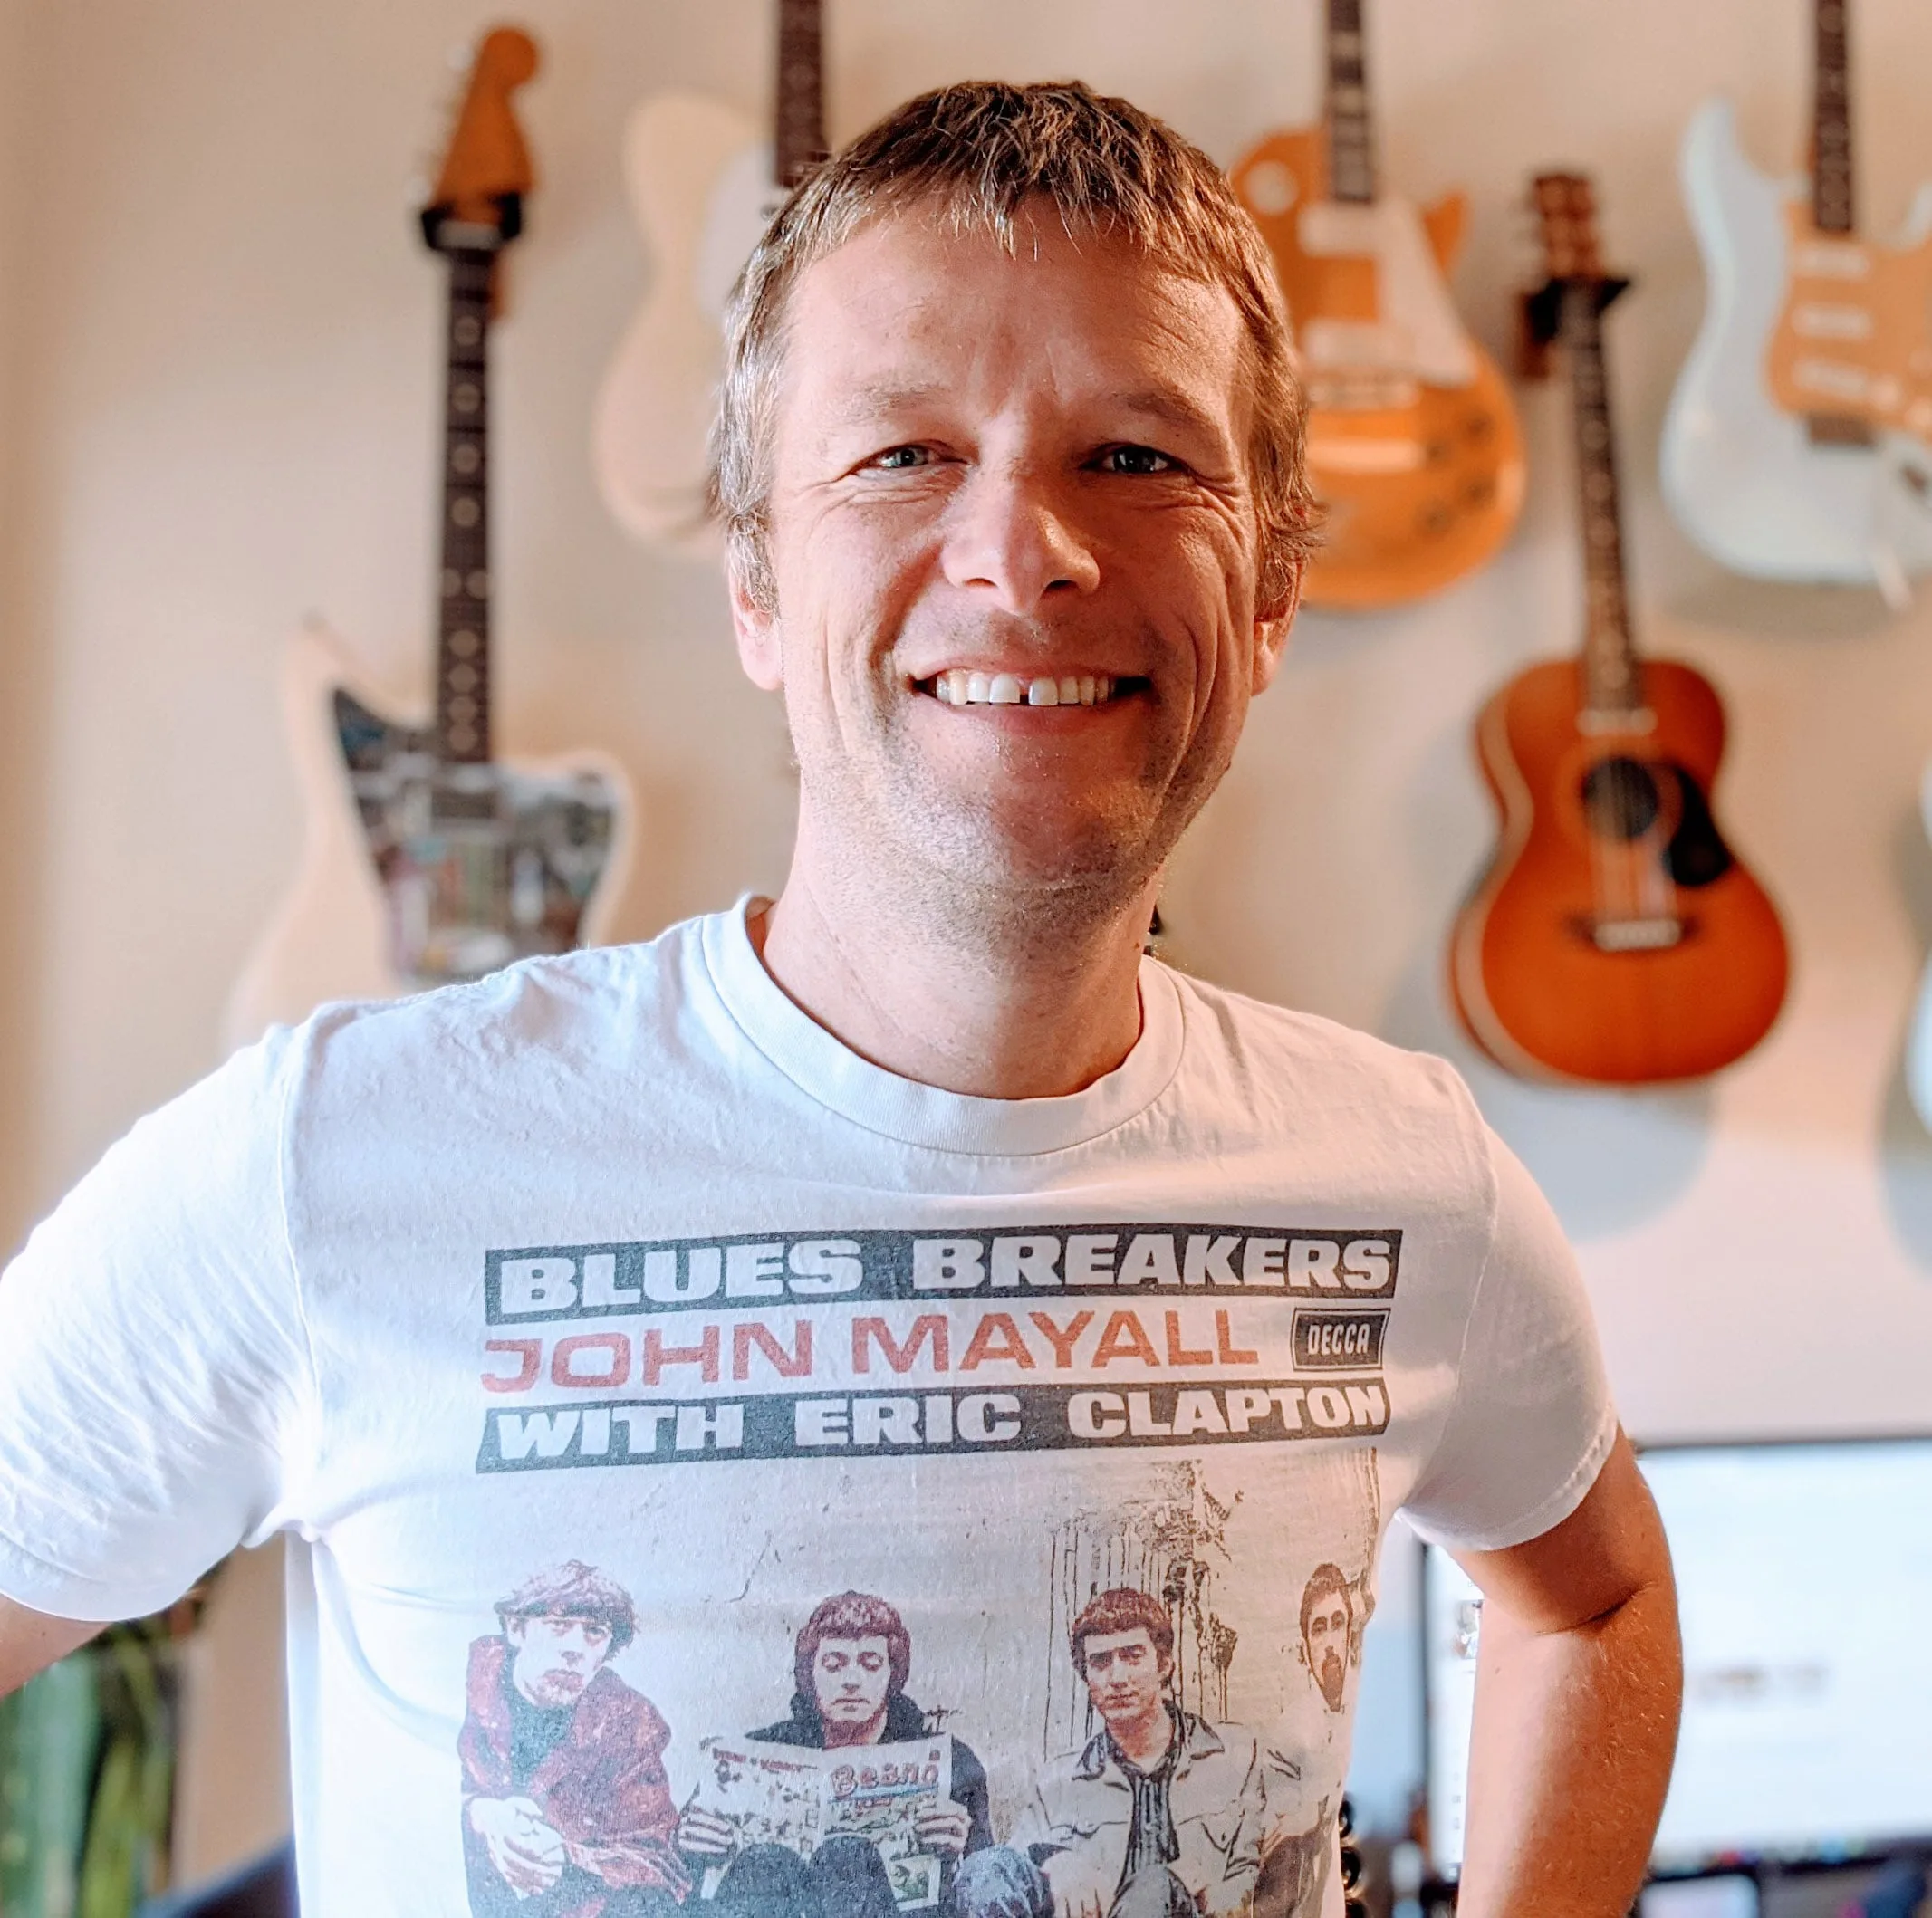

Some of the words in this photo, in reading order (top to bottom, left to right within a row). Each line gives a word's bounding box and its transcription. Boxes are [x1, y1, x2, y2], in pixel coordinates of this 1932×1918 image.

[501, 1239, 864, 1314] BLUES
[913, 1233, 1390, 1290] BREAKERS
[481, 1319, 812, 1393] JOHN
[851, 1309, 1259, 1373] MAYALL
[1307, 1323, 1370, 1356] DECCA
[497, 1404, 744, 1460] WITH
[794, 1395, 1022, 1449] ERIC
[1068, 1386, 1386, 1439] CLAPTON
